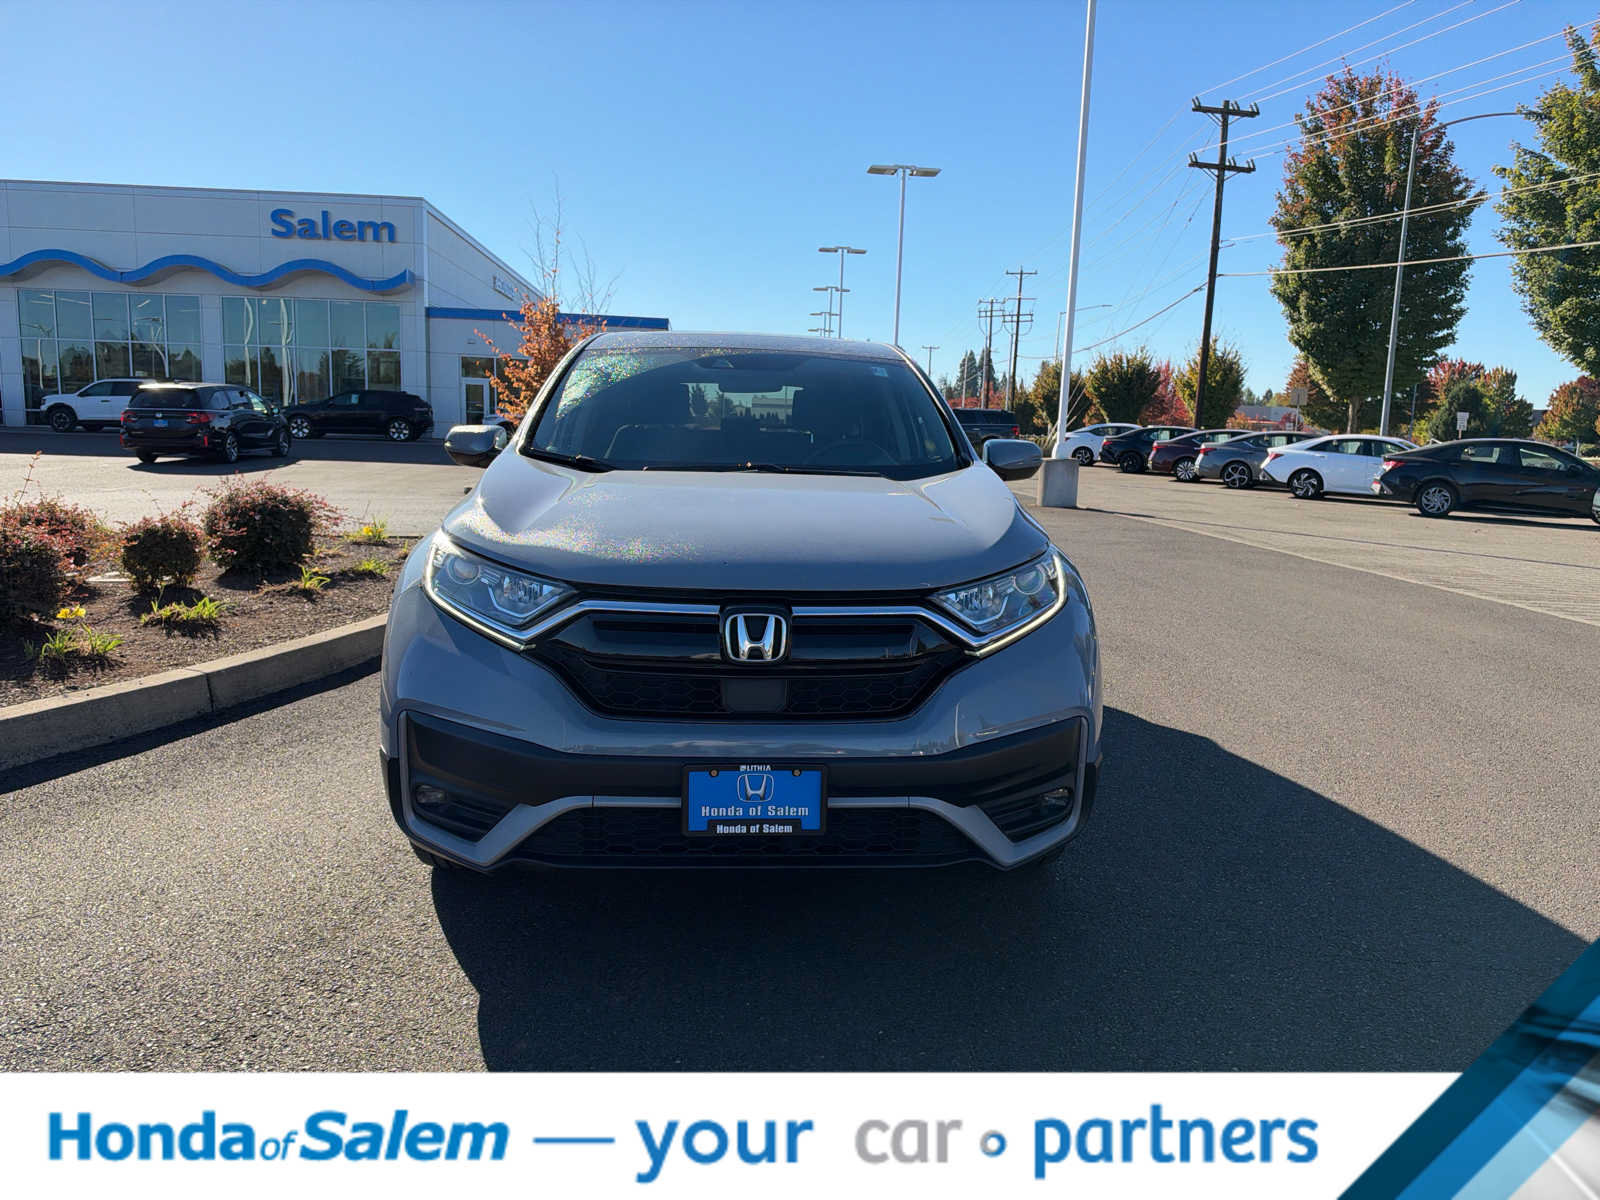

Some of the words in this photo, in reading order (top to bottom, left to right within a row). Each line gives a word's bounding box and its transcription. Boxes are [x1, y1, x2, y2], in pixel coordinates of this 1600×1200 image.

[270, 208, 396, 243] Salem
[701, 805, 743, 817] Honda
[749, 805, 762, 816] of
[768, 805, 809, 816] Salem
[716, 824, 747, 834] Honda
[750, 824, 760, 833] of
[762, 824, 793, 833] Salem
